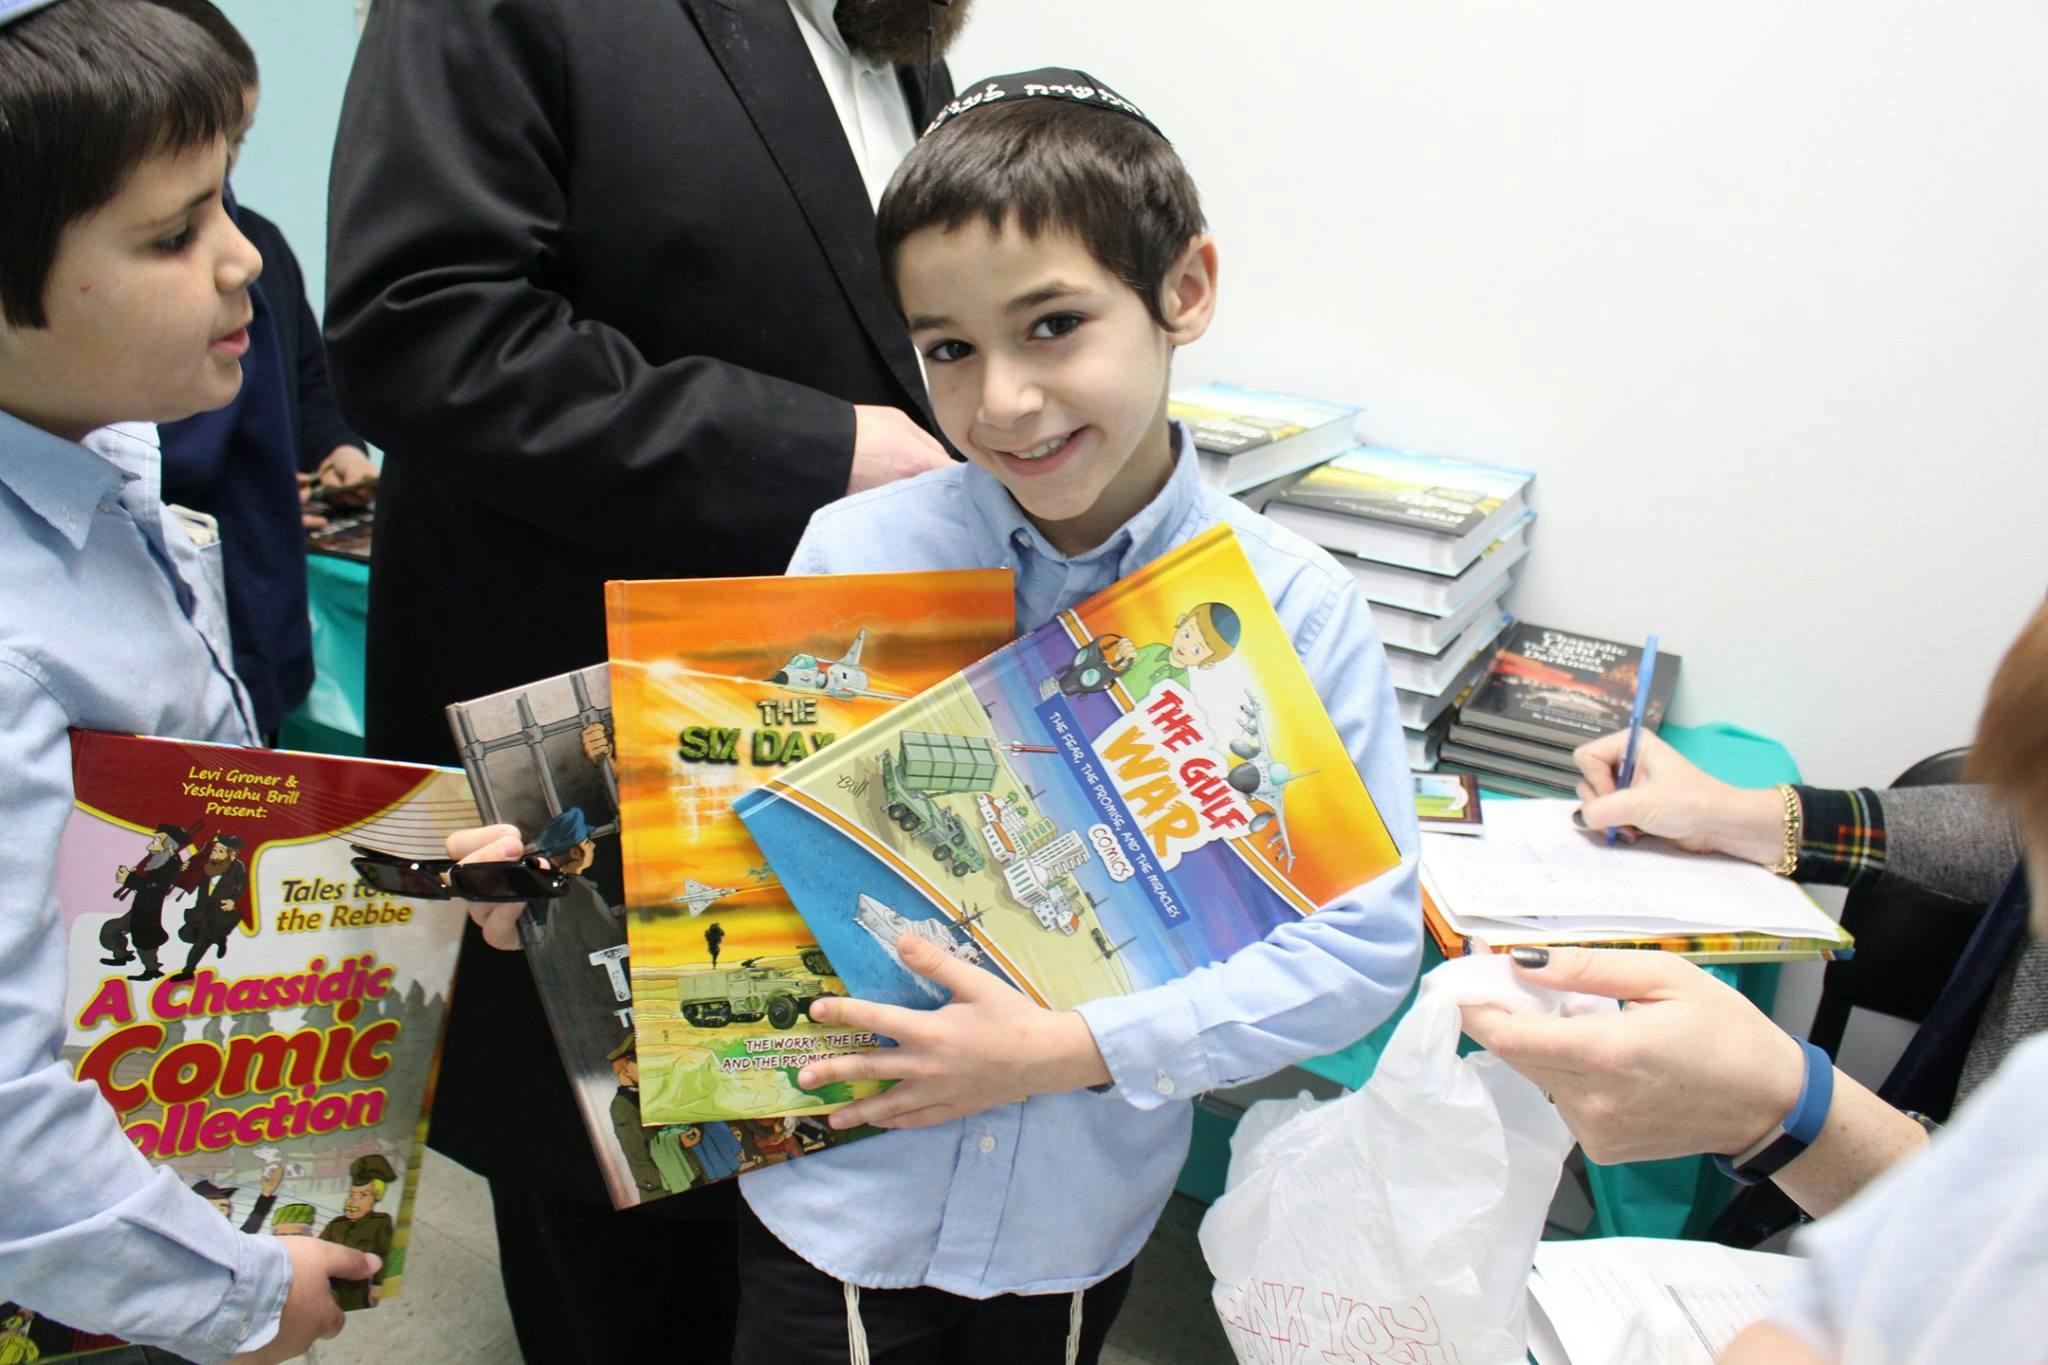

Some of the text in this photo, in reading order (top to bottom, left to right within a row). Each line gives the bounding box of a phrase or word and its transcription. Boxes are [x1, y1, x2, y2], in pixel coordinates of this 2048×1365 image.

[757, 699, 817, 726] THE
[680, 726, 742, 764] SIX
[1145, 689, 1249, 832] THE GULF
[182, 782, 300, 804] Yeshayahu Brill
[189, 766, 299, 788] Levi Groner &
[1101, 724, 1200, 859] WAR
[1049, 711, 1181, 918] THE FEAR, THE PROMISE, AND THE MIRACLES
[1092, 827, 1130, 877] COMICS
[282, 878, 345, 902] Tales
[277, 902, 412, 931] the Rebbe
[78, 953, 395, 1028] A Chassidic
[76, 998, 400, 1112] Comic
[723, 1056, 750, 1072] AND
[755, 1055, 778, 1069] THE
[746, 1039, 770, 1052] THE
[826, 1034, 850, 1048] THE
[854, 1032, 879, 1047] FEA
[122, 1082, 387, 1159] ollection
[1320, 1292, 1441, 1356] YOU
